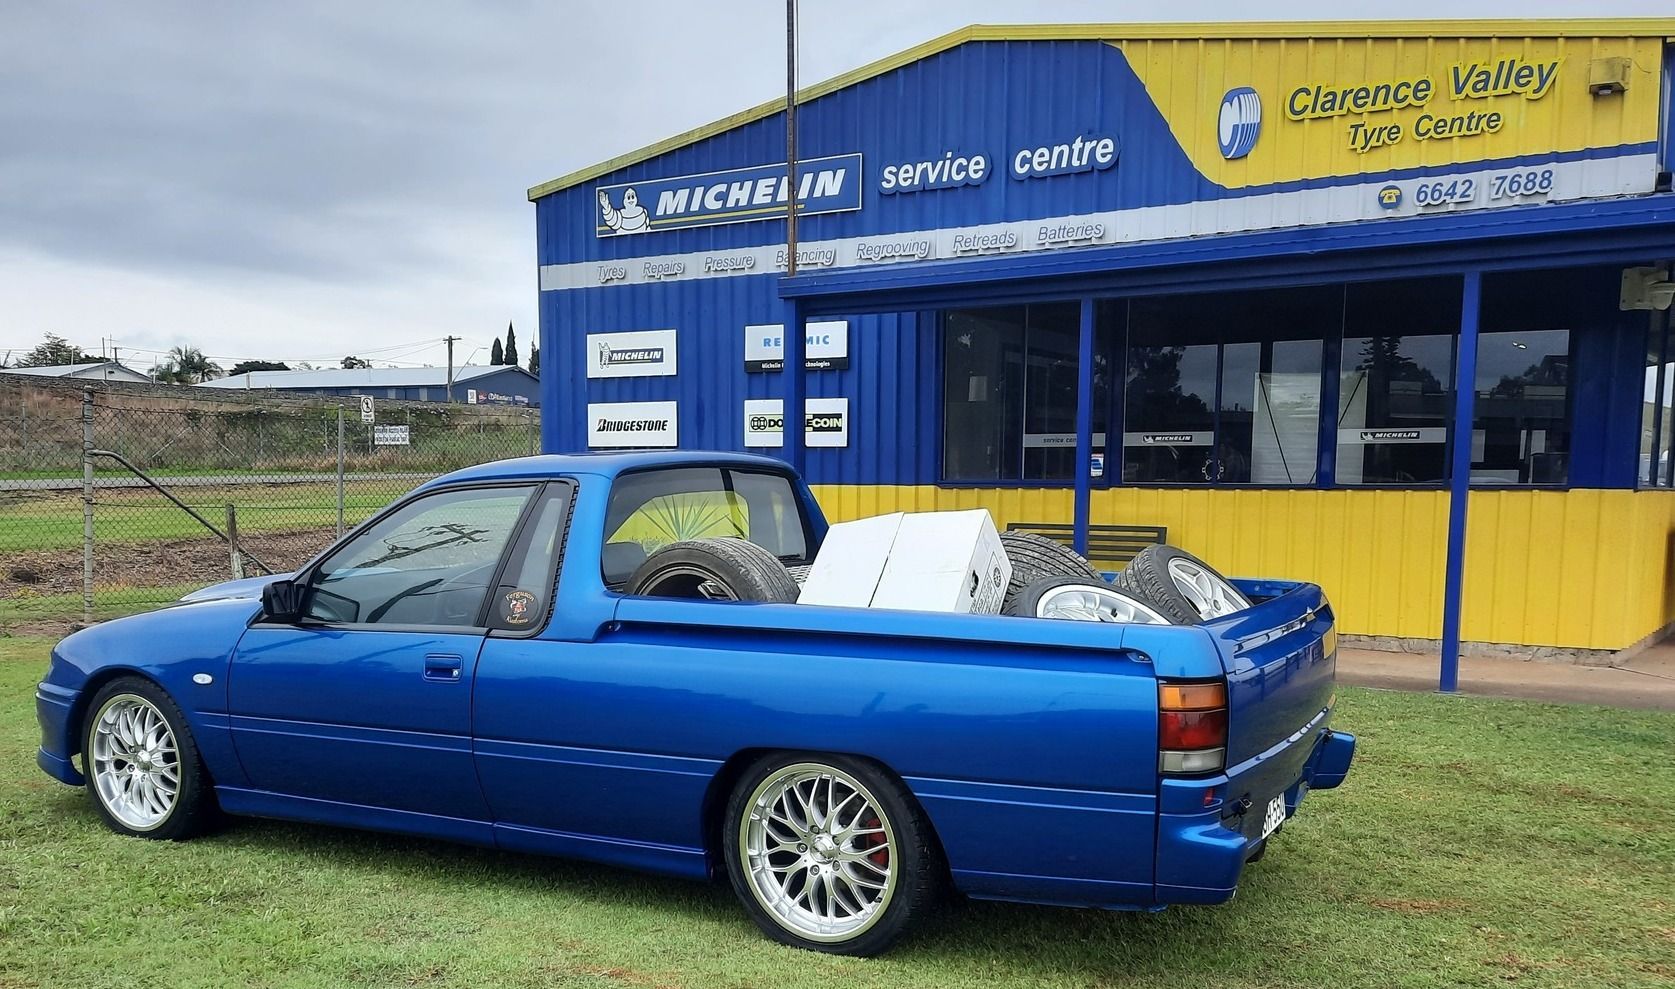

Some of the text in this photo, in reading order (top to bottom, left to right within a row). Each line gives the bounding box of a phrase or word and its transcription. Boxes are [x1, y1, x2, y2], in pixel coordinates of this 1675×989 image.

[1288, 58, 1558, 116] Clarence Valley
[1348, 110, 1501, 151] Tyre Centre
[881, 135, 1114, 189] service centre
[655, 168, 846, 216] MICHELIN
[1415, 169, 1553, 204] 6642 7688
[597, 222, 1102, 281] Tyres Repairs Pressure Baancing Regrooving Retreads Batteries
[610, 350, 662, 361] MICHELIN
[596, 418, 668, 432] BRIDGESTONE
